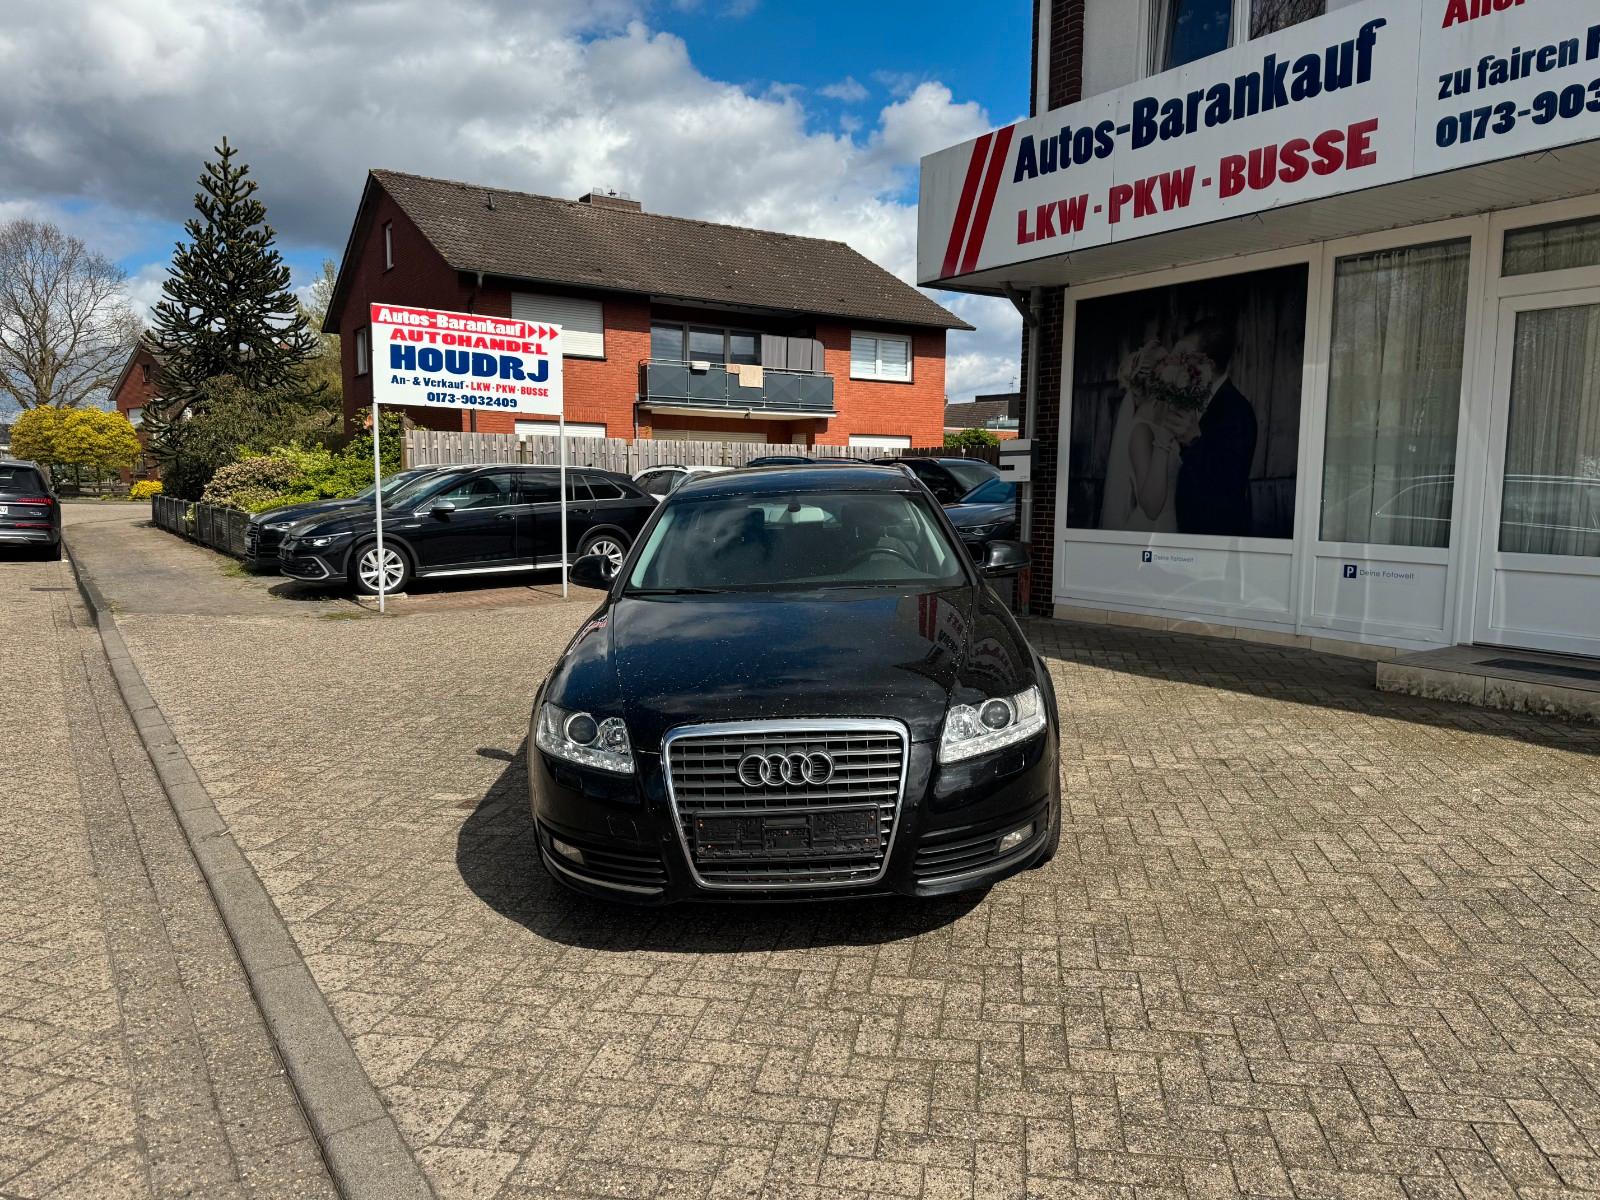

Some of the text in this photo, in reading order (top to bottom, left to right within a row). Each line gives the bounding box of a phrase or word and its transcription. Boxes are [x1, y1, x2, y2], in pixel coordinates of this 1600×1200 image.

[1438, 67, 1471, 100] zu
[1477, 38, 1579, 89] fairen
[1013, 17, 1387, 183] Autos-Barankauf
[1017, 118, 1378, 245] LKW PKW BUSSE
[378, 308, 523, 337] Autos-Barankauf
[390, 328, 548, 356] AUTOHANDEL
[390, 343, 549, 382] HOUDRJ
[391, 374, 549, 397] An- & Verkauf LKW PKW BUSSE
[427, 391, 517, 408] 0173-9032409
[1360, 569, 1380, 577] Deine
